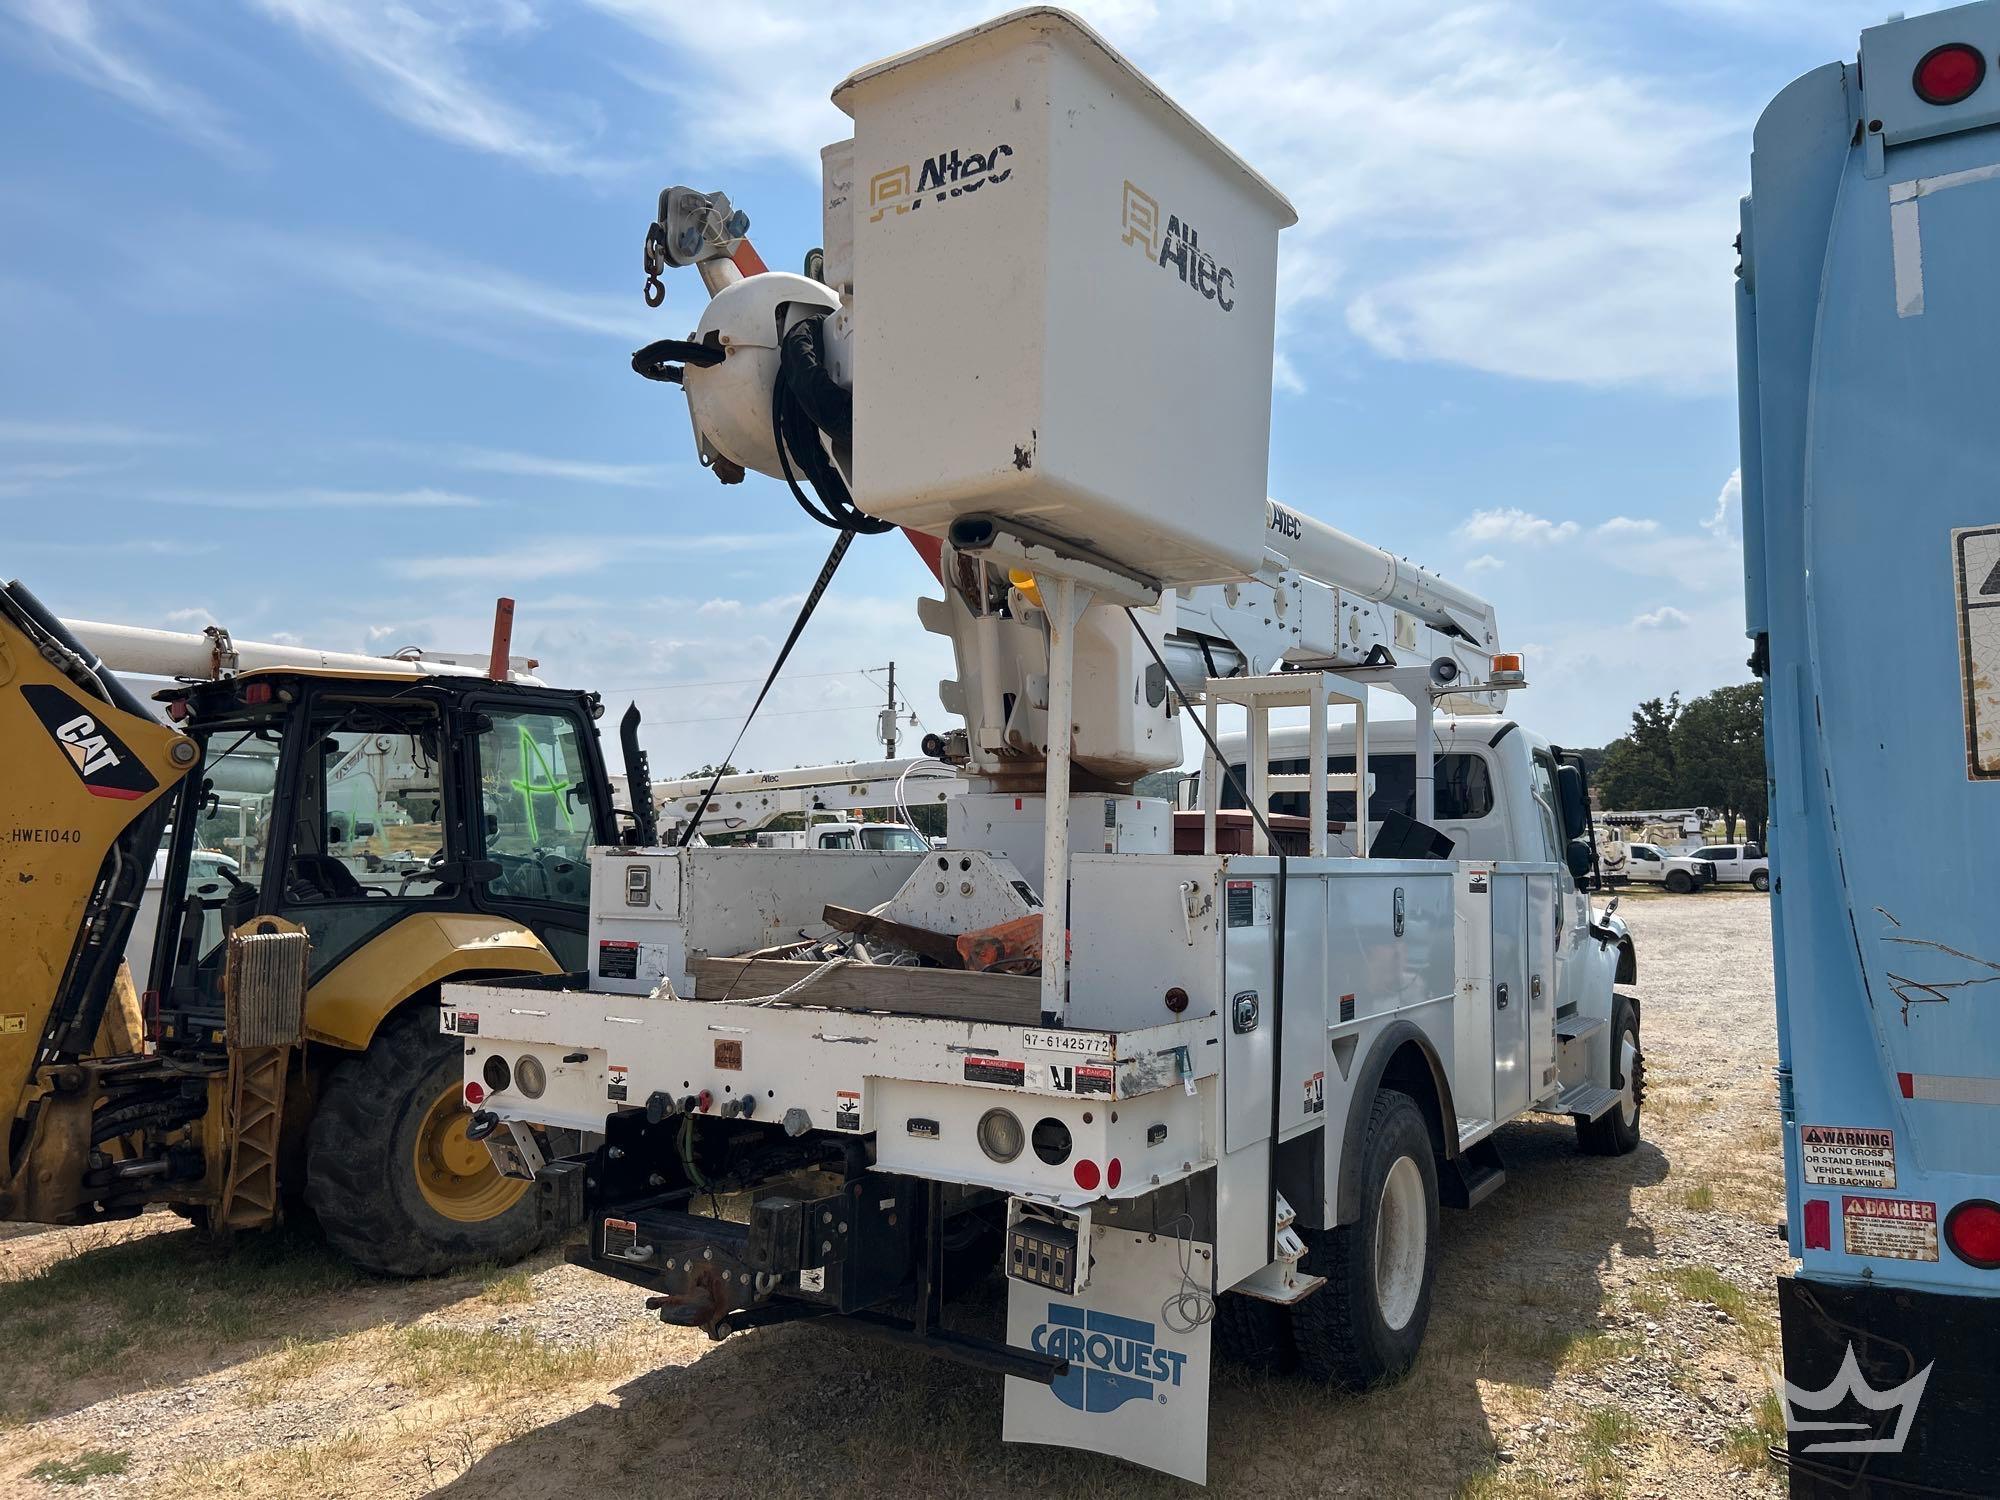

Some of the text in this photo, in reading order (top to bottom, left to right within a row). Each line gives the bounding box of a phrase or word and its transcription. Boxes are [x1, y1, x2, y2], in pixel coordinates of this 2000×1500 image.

[56, 714, 120, 777] CAT
[12, 829, 81, 843] HWE1040
[1024, 1033, 1109, 1052] 97-61425772
[1086, 1069, 1111, 1077] DANGER
[1823, 1131, 1890, 1147] WARNING
[1828, 1147, 1848, 1155] NOT
[1851, 1149, 1884, 1157] CROSS
[1822, 1157, 1852, 1165] STAND
[1855, 1159, 1891, 1168] BEHIND
[1813, 1166, 1885, 1177] VEHICLE WHILE
[1839, 1178, 1882, 1187] BACKING
[1865, 1200, 1933, 1220] DANGER
[1031, 1324, 1187, 1386] CARQUEST
